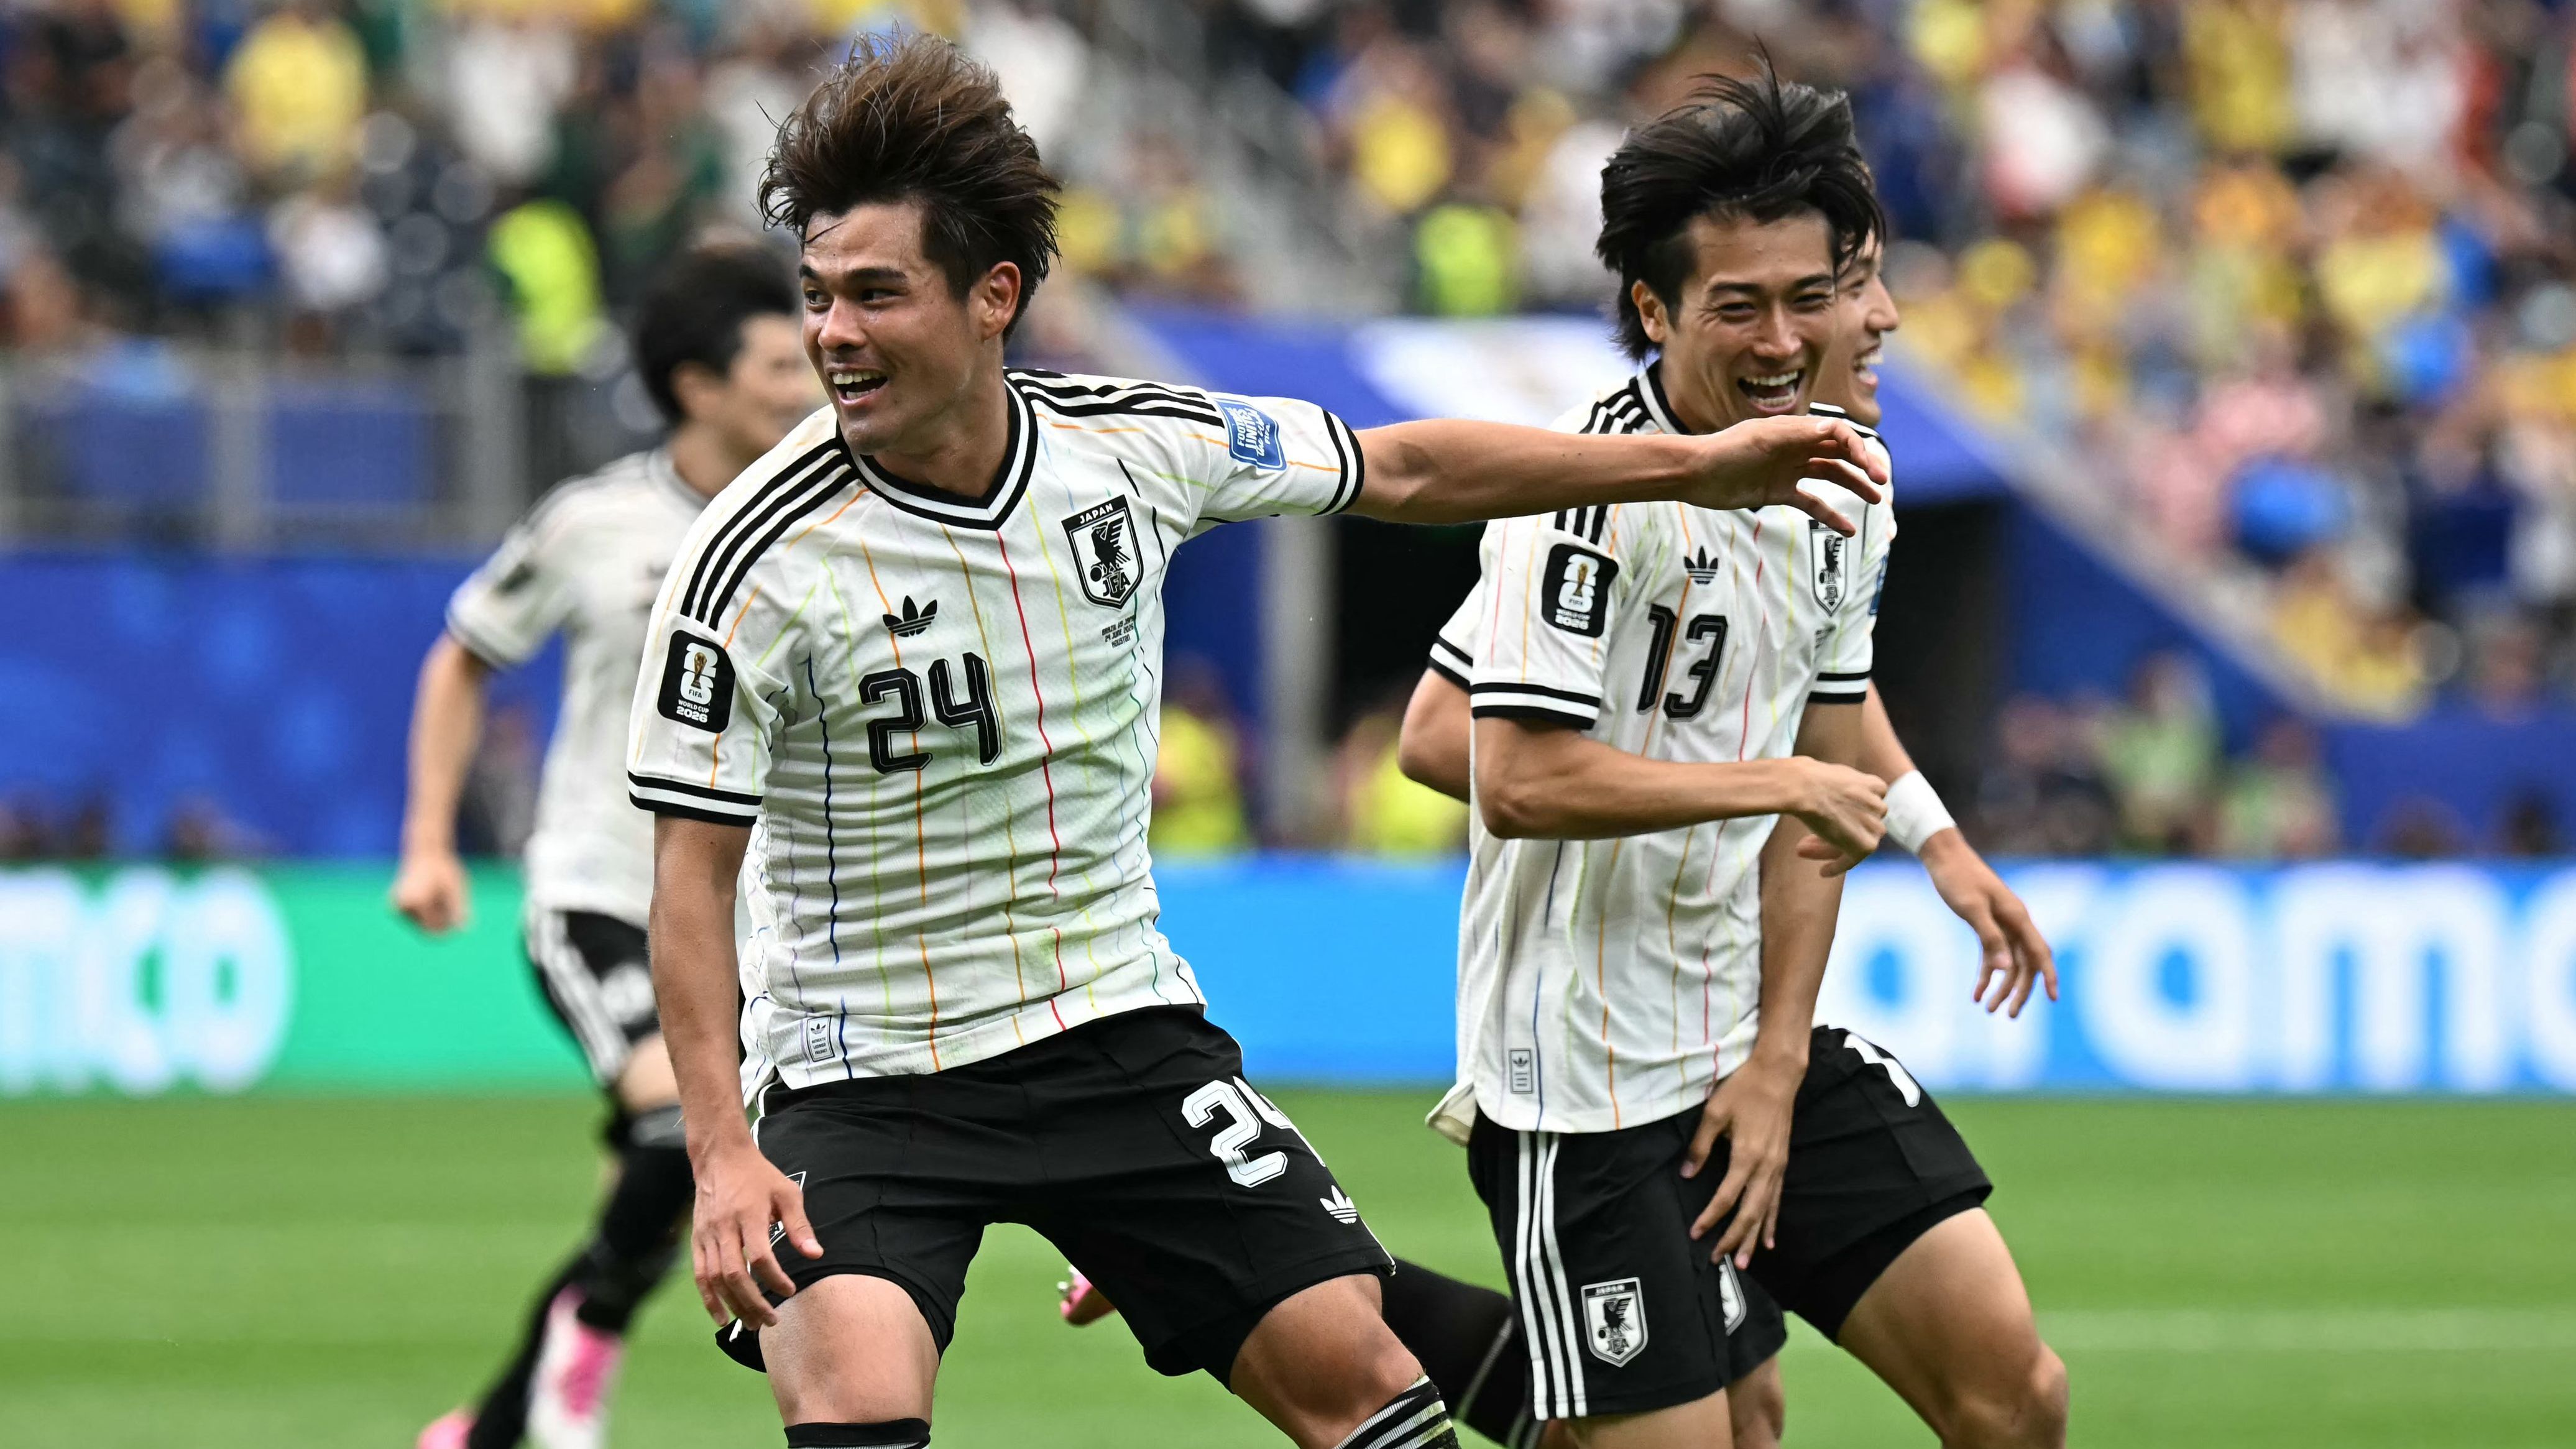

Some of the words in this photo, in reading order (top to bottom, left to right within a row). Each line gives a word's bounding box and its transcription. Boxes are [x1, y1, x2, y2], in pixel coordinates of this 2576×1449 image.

[1080, 503, 1113, 525] JAPAN
[1102, 571, 1131, 597] JFA
[1637, 603, 1728, 722] 13
[688, 689, 702, 699] FIFA
[676, 706, 708, 723] 2026
[678, 699, 697, 711] WORLD
[698, 706, 709, 714] CUP
[858, 651, 1001, 775] 24
